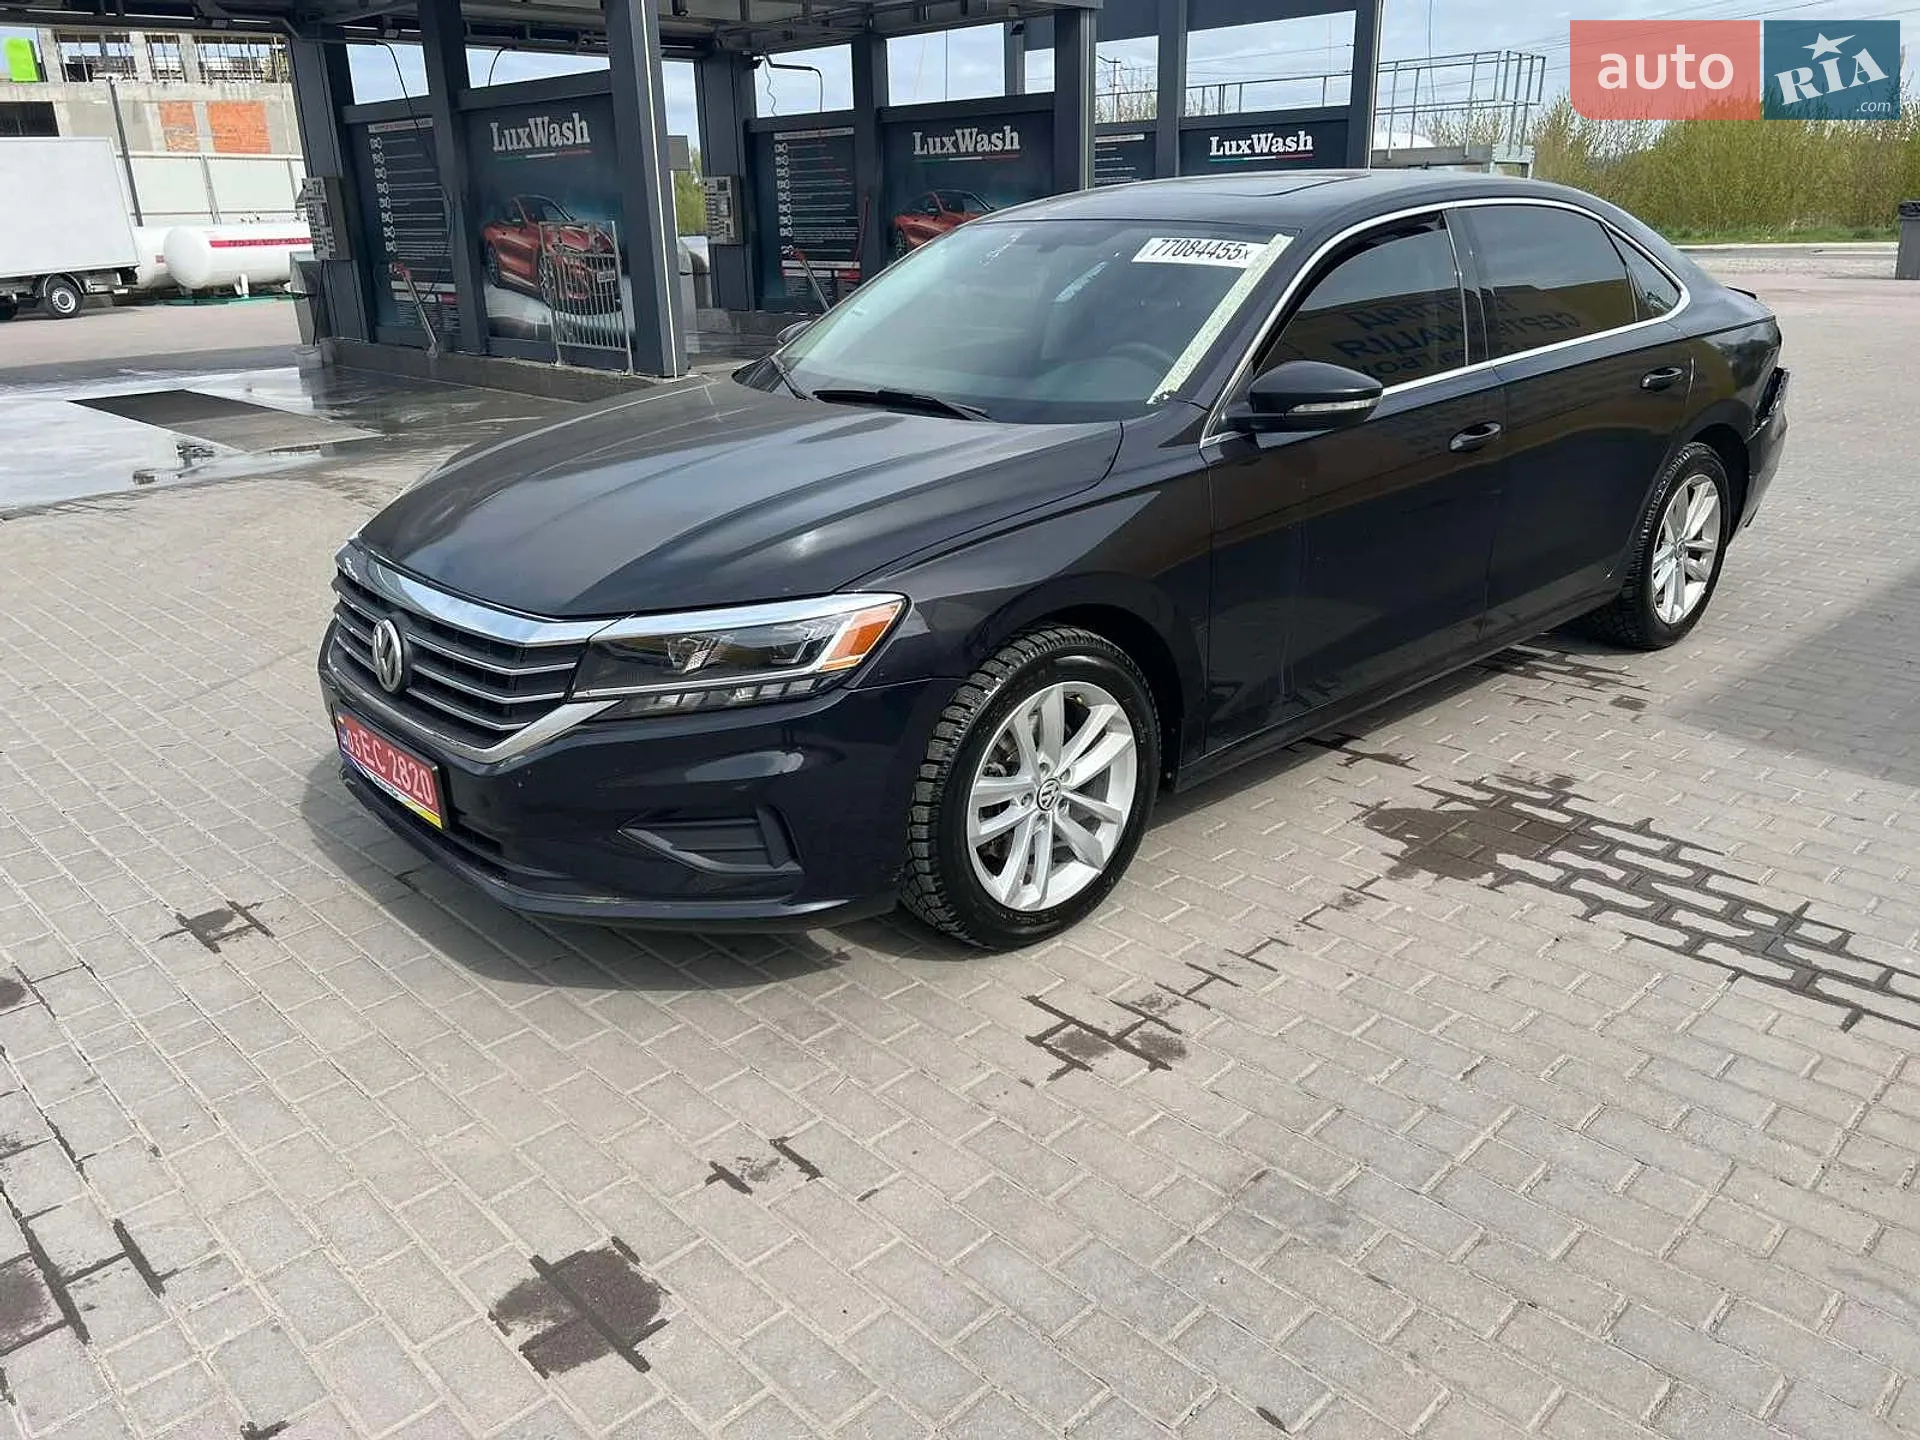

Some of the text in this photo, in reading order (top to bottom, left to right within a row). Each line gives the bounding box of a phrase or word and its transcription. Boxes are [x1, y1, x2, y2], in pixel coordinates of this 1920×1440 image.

[489, 112, 591, 152] LuxWash
[912, 125, 1020, 155] LuxWash
[1209, 130, 1314, 156] LuxWash
[387, 749, 433, 805] 2820
